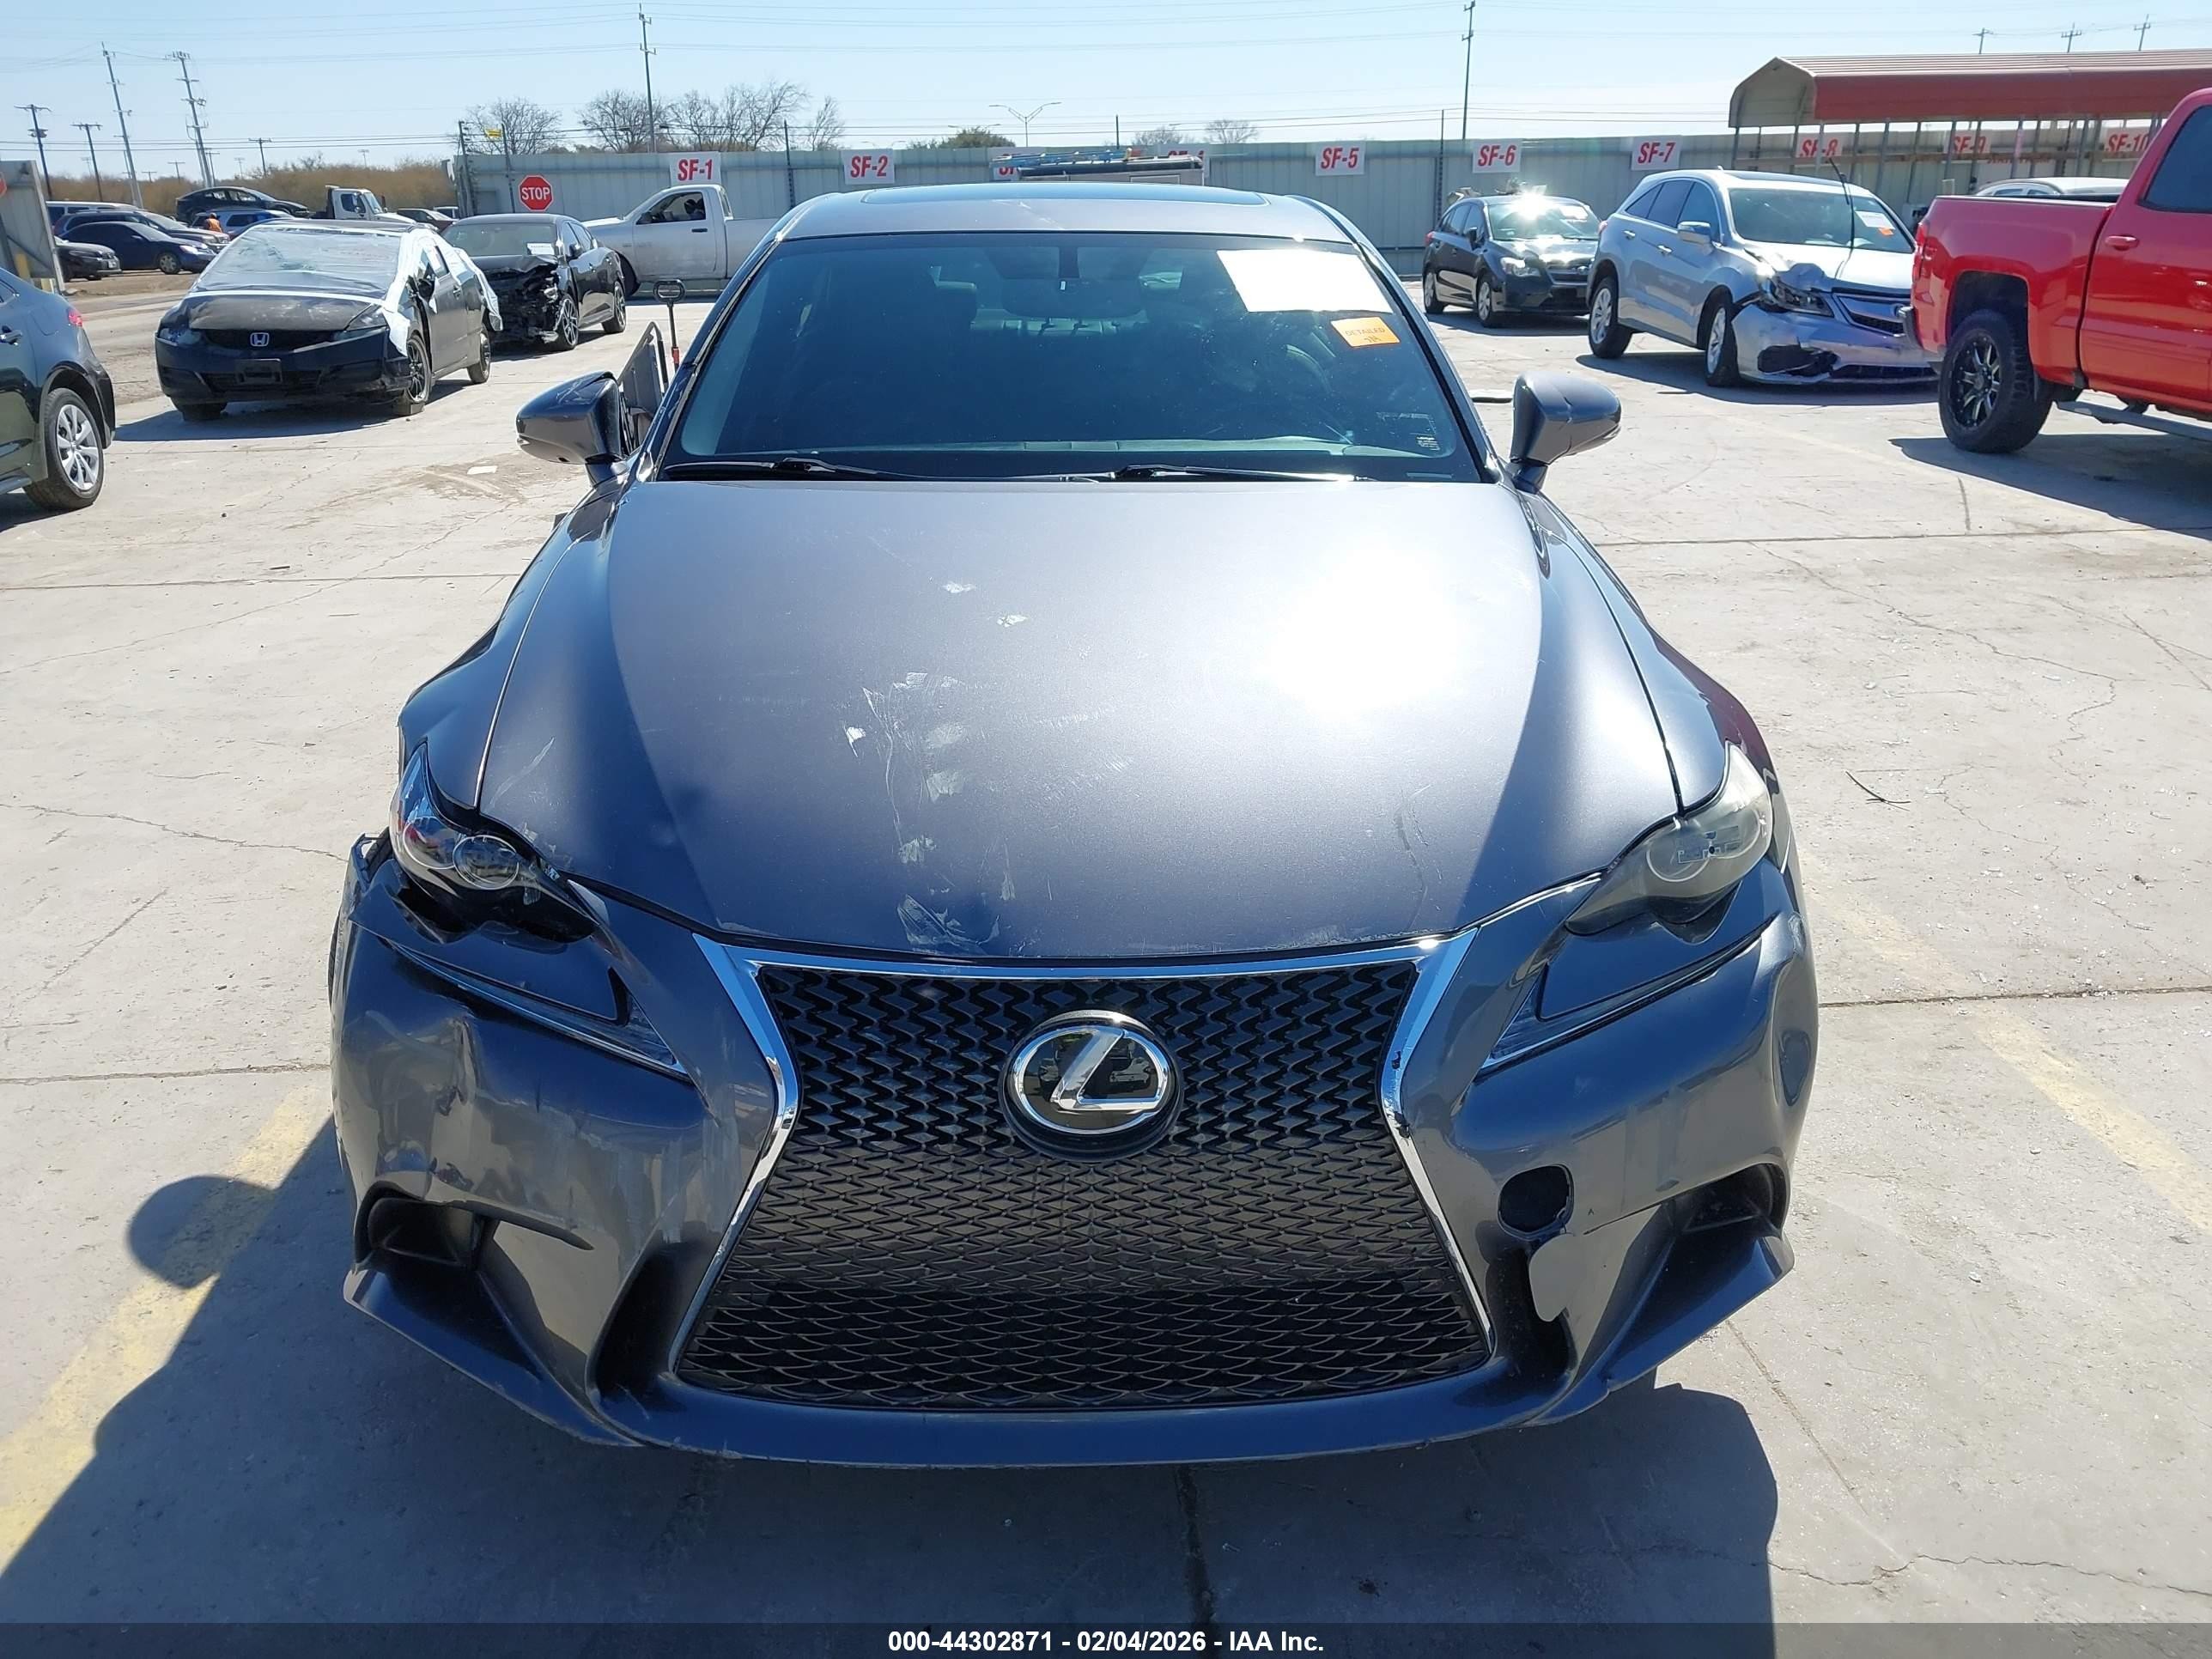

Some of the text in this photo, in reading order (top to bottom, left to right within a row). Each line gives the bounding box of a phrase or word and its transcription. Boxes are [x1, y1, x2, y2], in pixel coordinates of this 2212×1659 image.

[1320, 147, 1359, 169] SF-5
[1478, 144, 1516, 167] SF-6
[1638, 142, 1675, 164] SF-7
[677, 159, 713, 182] SF-1
[850, 155, 889, 178] SF-2
[521, 186, 550, 200] STOP
